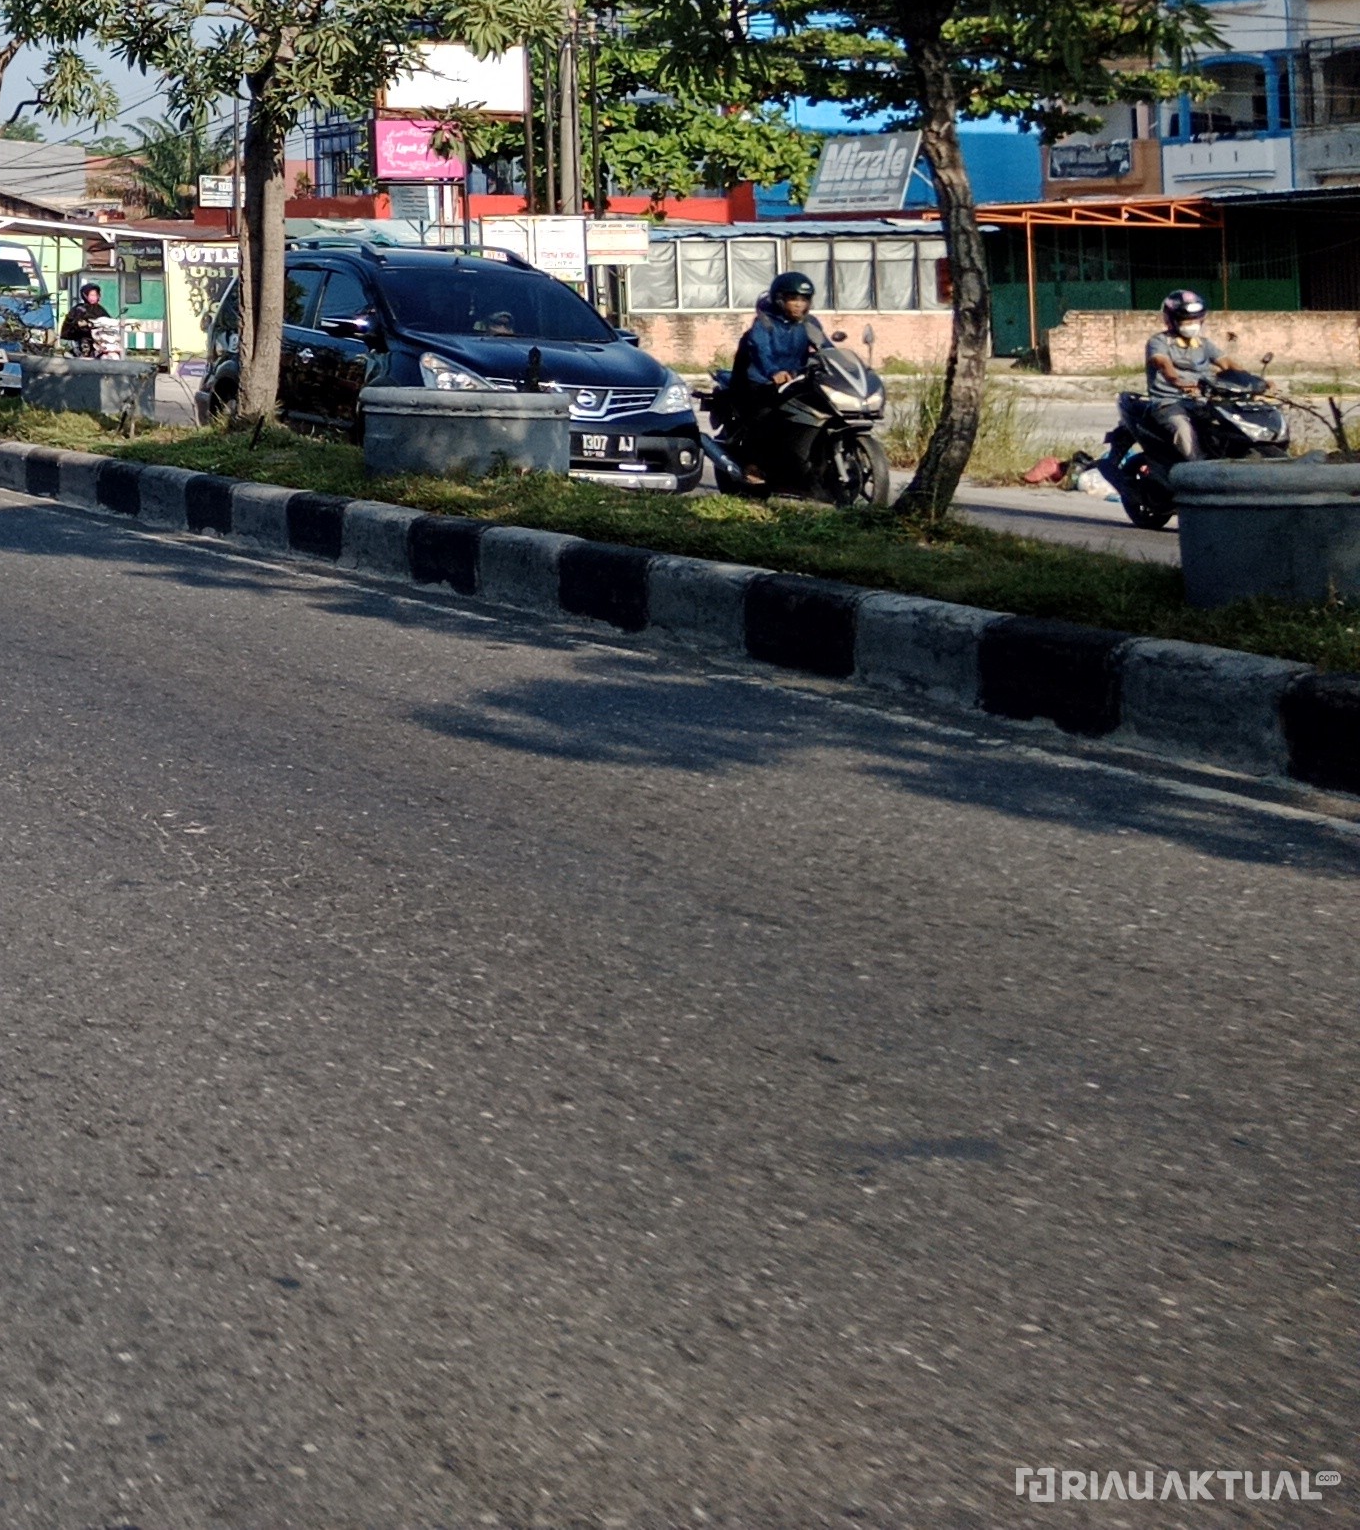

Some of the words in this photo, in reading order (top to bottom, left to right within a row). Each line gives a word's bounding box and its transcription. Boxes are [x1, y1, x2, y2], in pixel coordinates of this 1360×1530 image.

[819, 137, 909, 182] Mizzle
[169, 247, 239, 263] OUTLE
[582, 434, 608, 451] 1307
[618, 436, 634, 452] AJ
